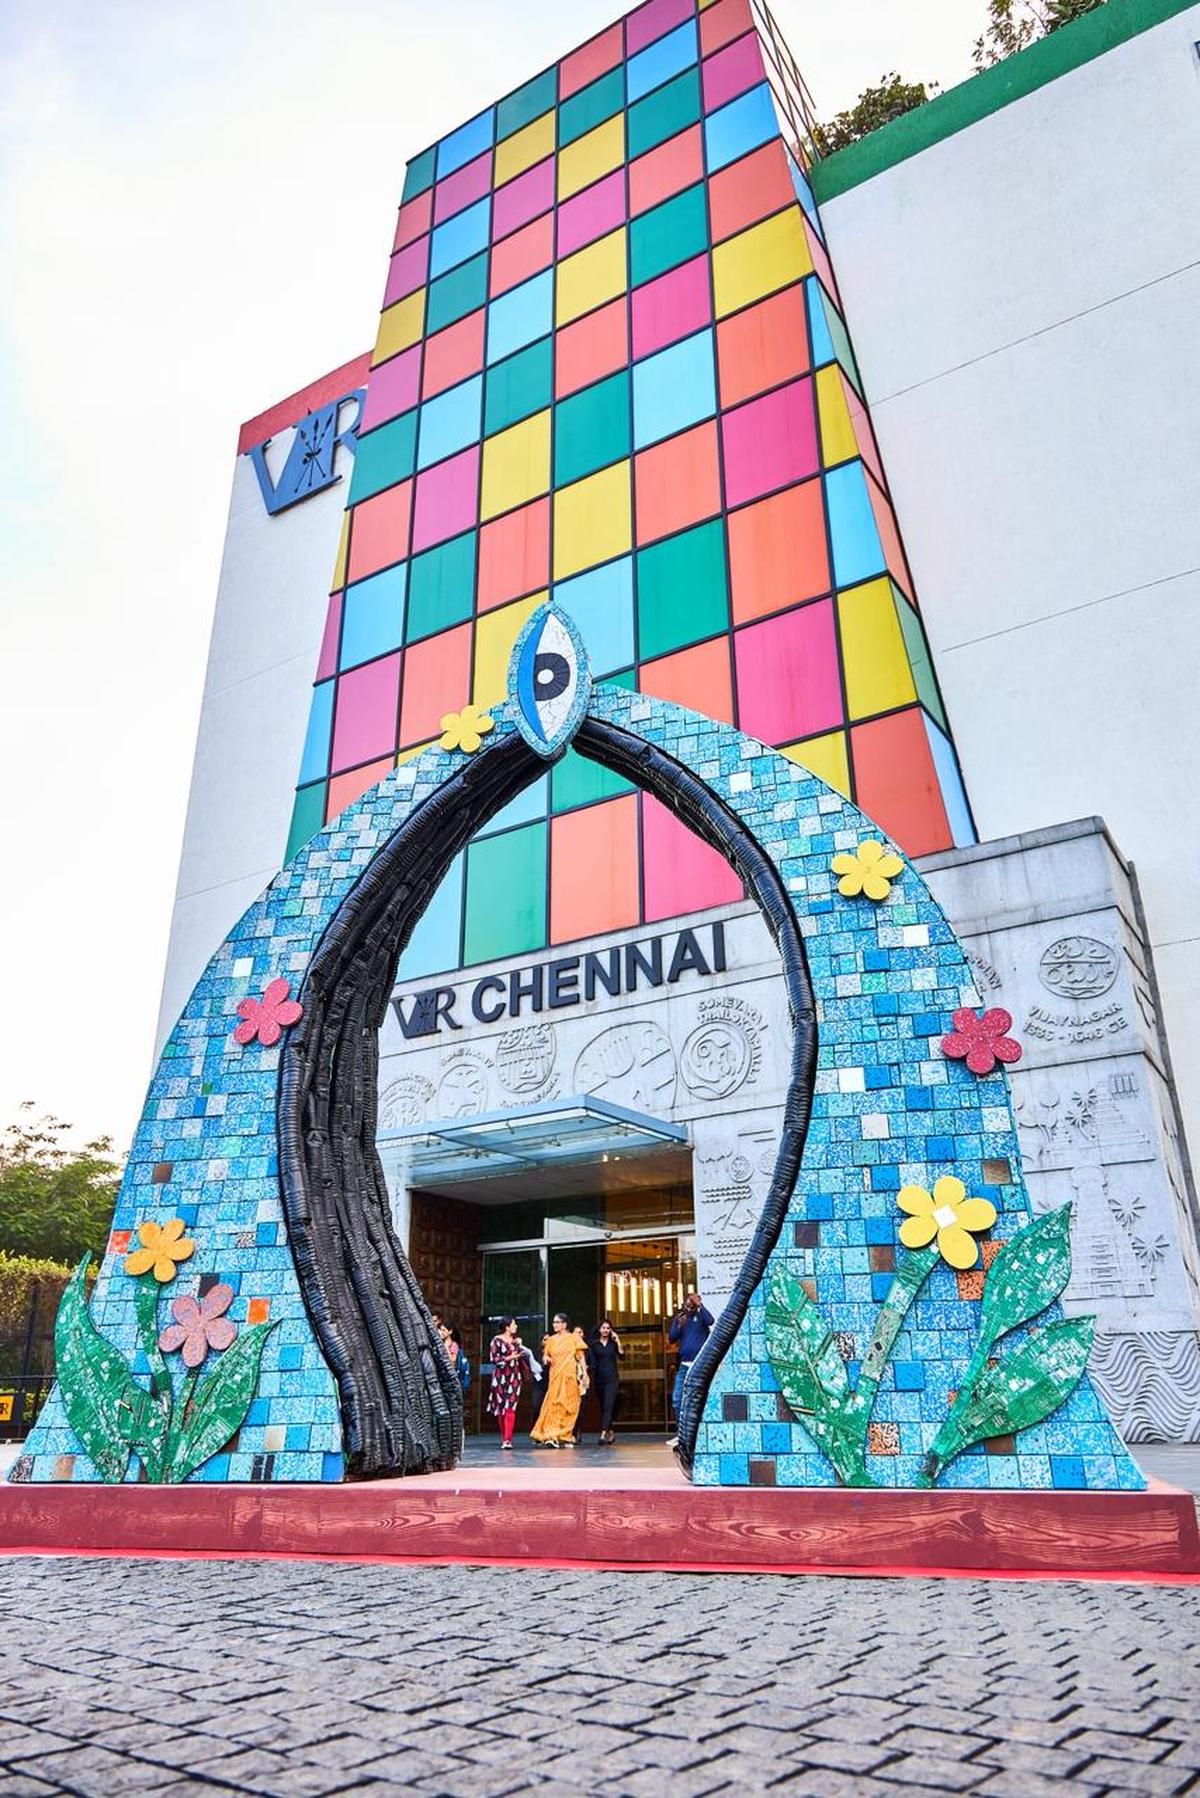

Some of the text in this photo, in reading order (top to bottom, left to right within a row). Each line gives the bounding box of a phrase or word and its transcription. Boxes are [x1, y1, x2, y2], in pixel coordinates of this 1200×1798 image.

[388, 922, 727, 1040] VR CHENNAI
[1106, 1017, 1129, 1034] CE
